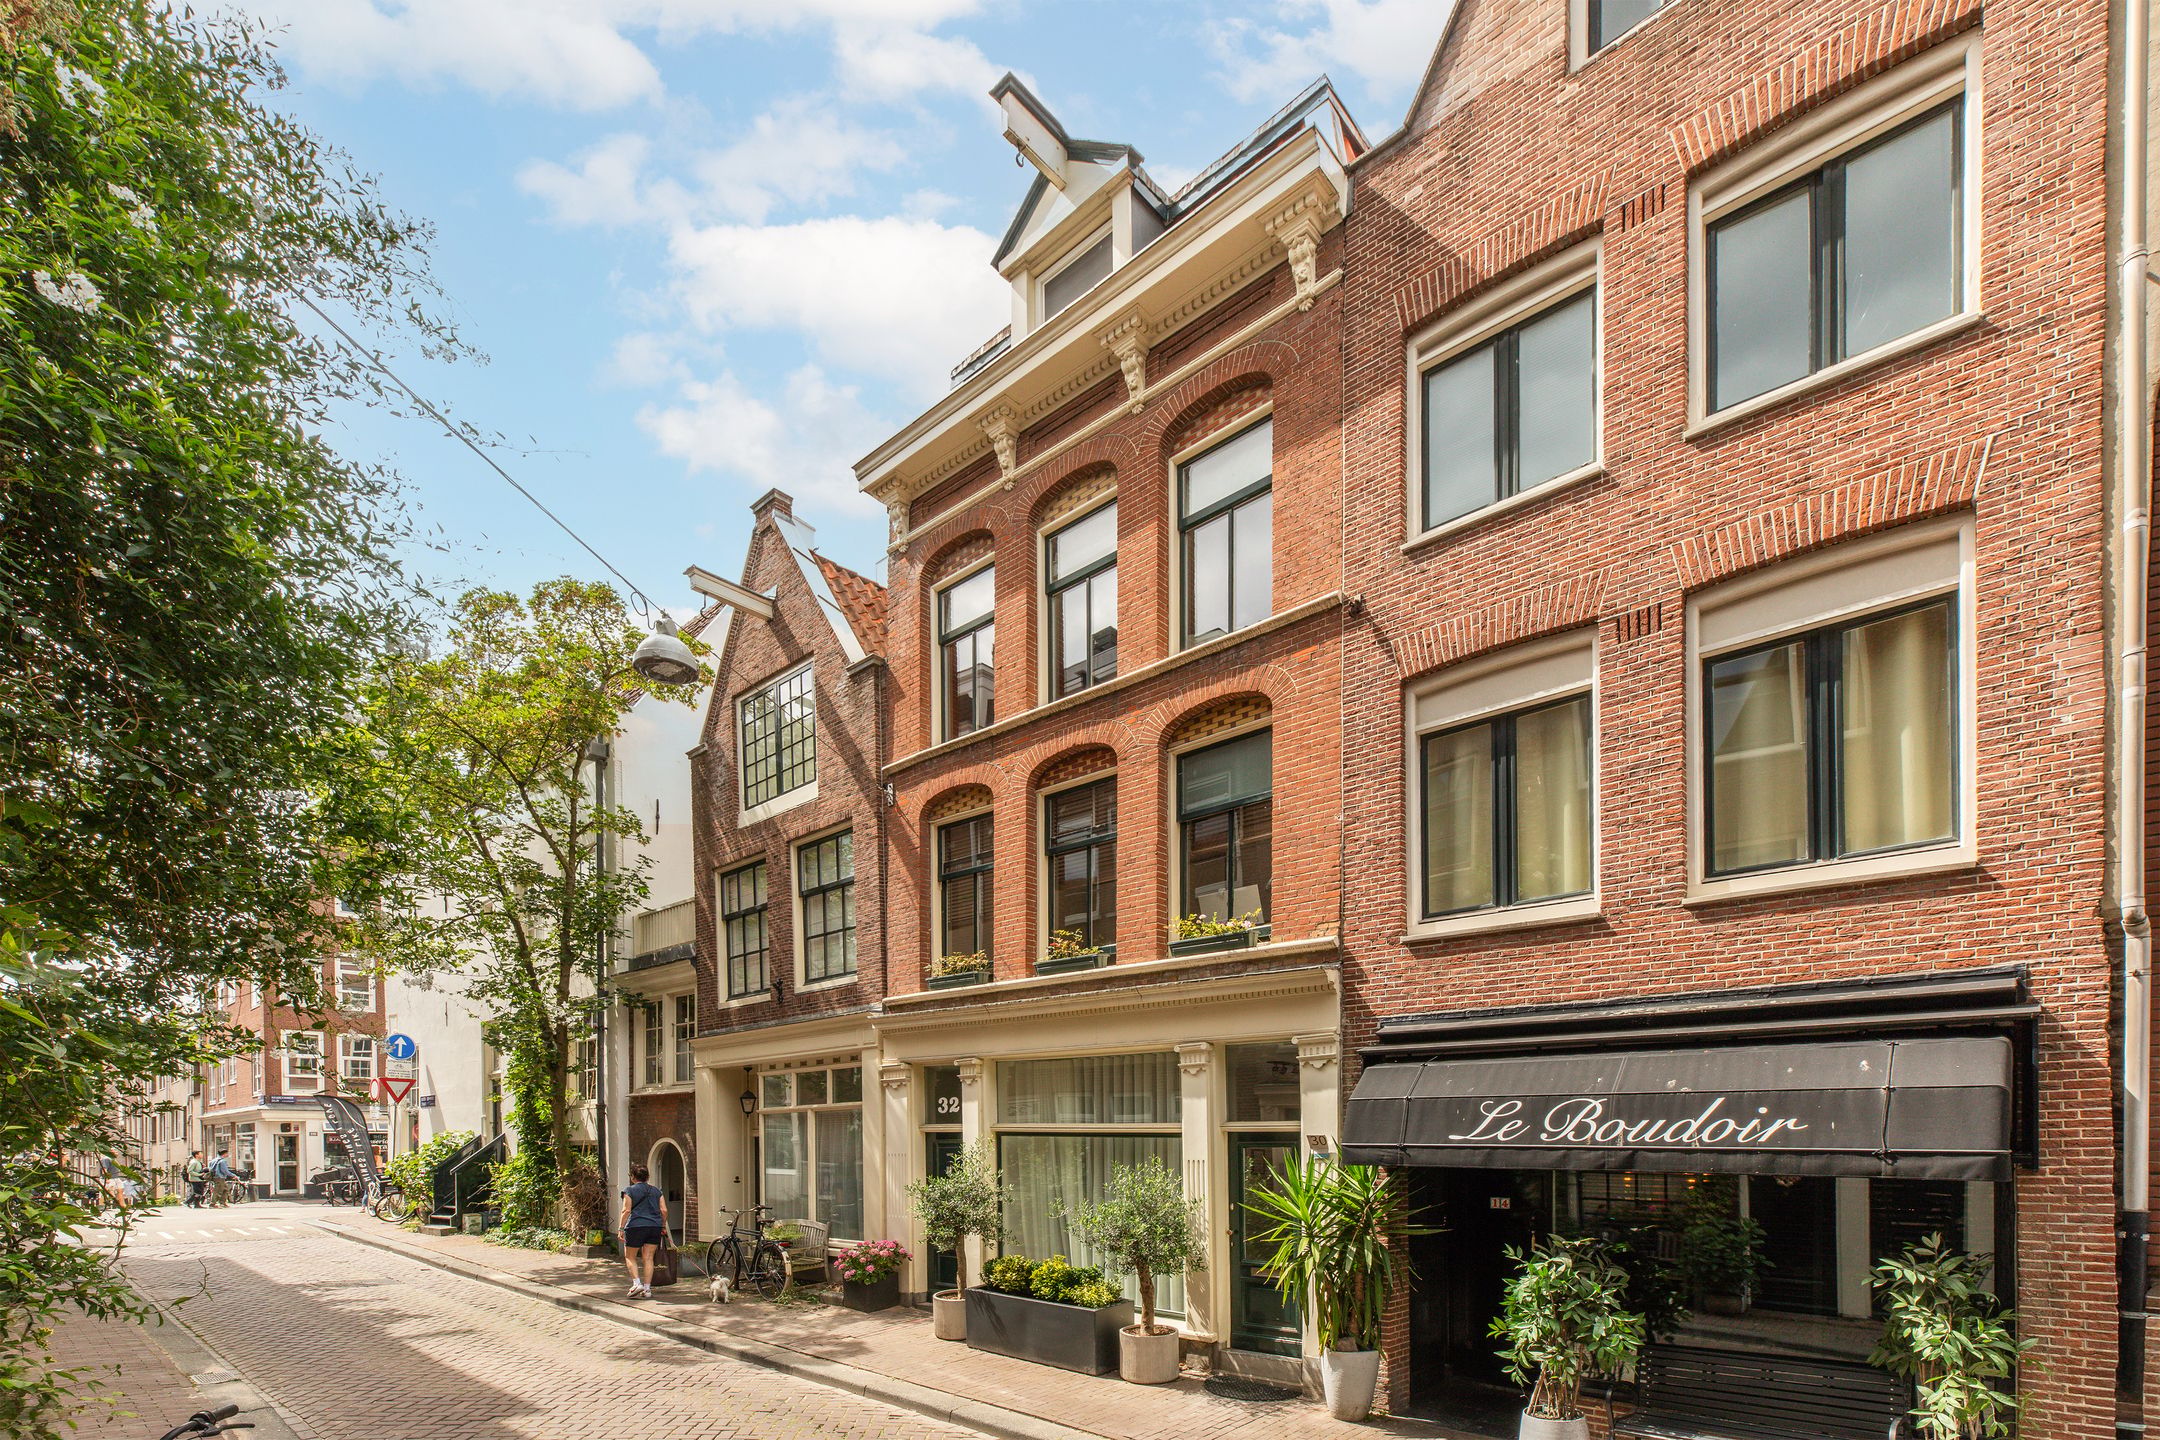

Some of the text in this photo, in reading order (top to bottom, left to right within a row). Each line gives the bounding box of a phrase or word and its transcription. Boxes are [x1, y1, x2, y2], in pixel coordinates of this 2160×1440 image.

[937, 1096, 960, 1114] 32
[1448, 1097, 1809, 1144] Le Boudoir
[1310, 1135, 1327, 1145] 30
